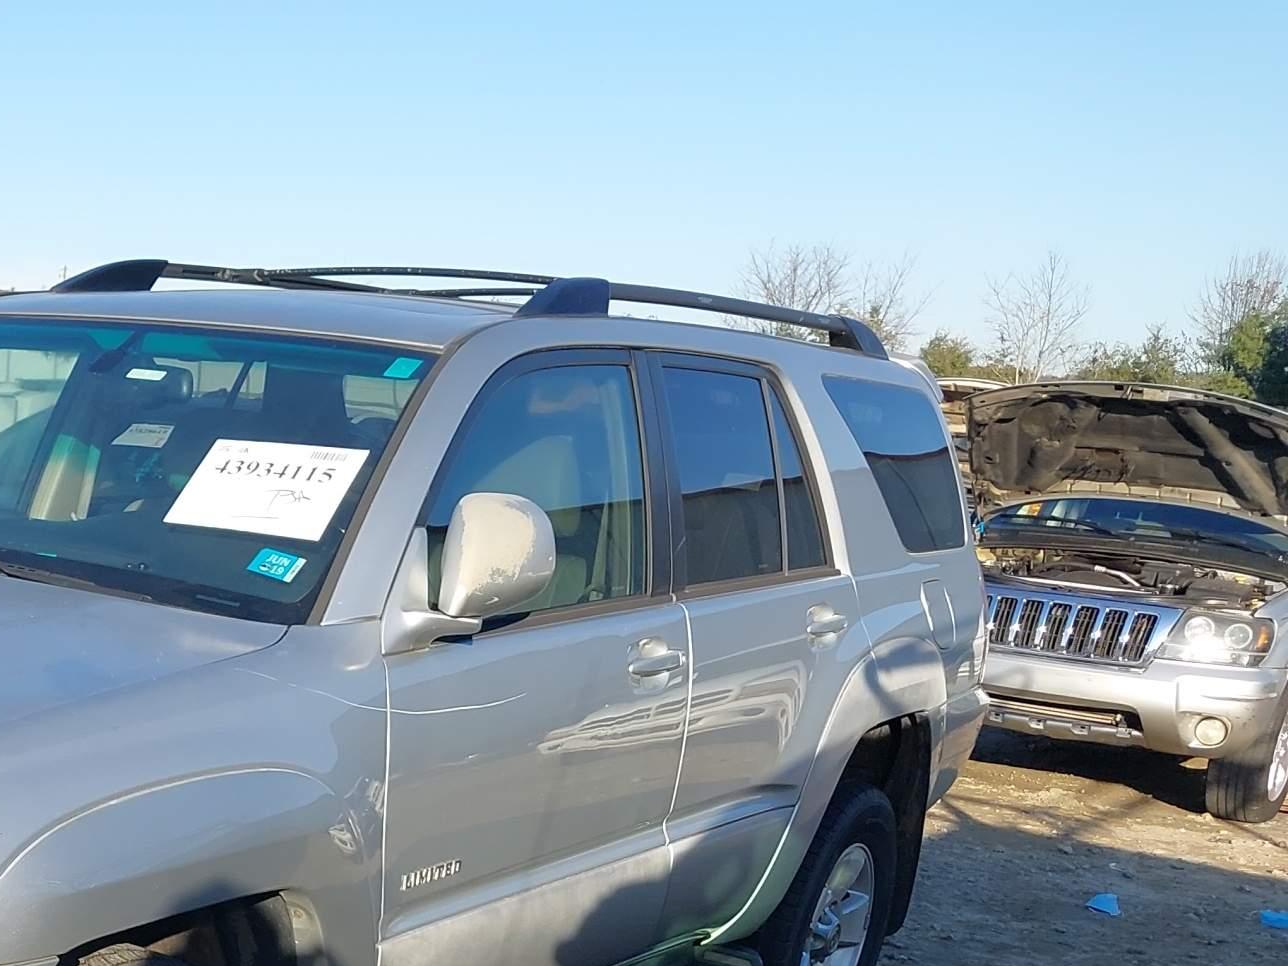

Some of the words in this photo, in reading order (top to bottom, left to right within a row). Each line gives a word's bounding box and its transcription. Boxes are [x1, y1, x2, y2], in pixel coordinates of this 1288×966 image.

[215, 459, 337, 483] 43934115
[266, 554, 292, 567] JUN
[400, 859, 461, 891] LIMITED
